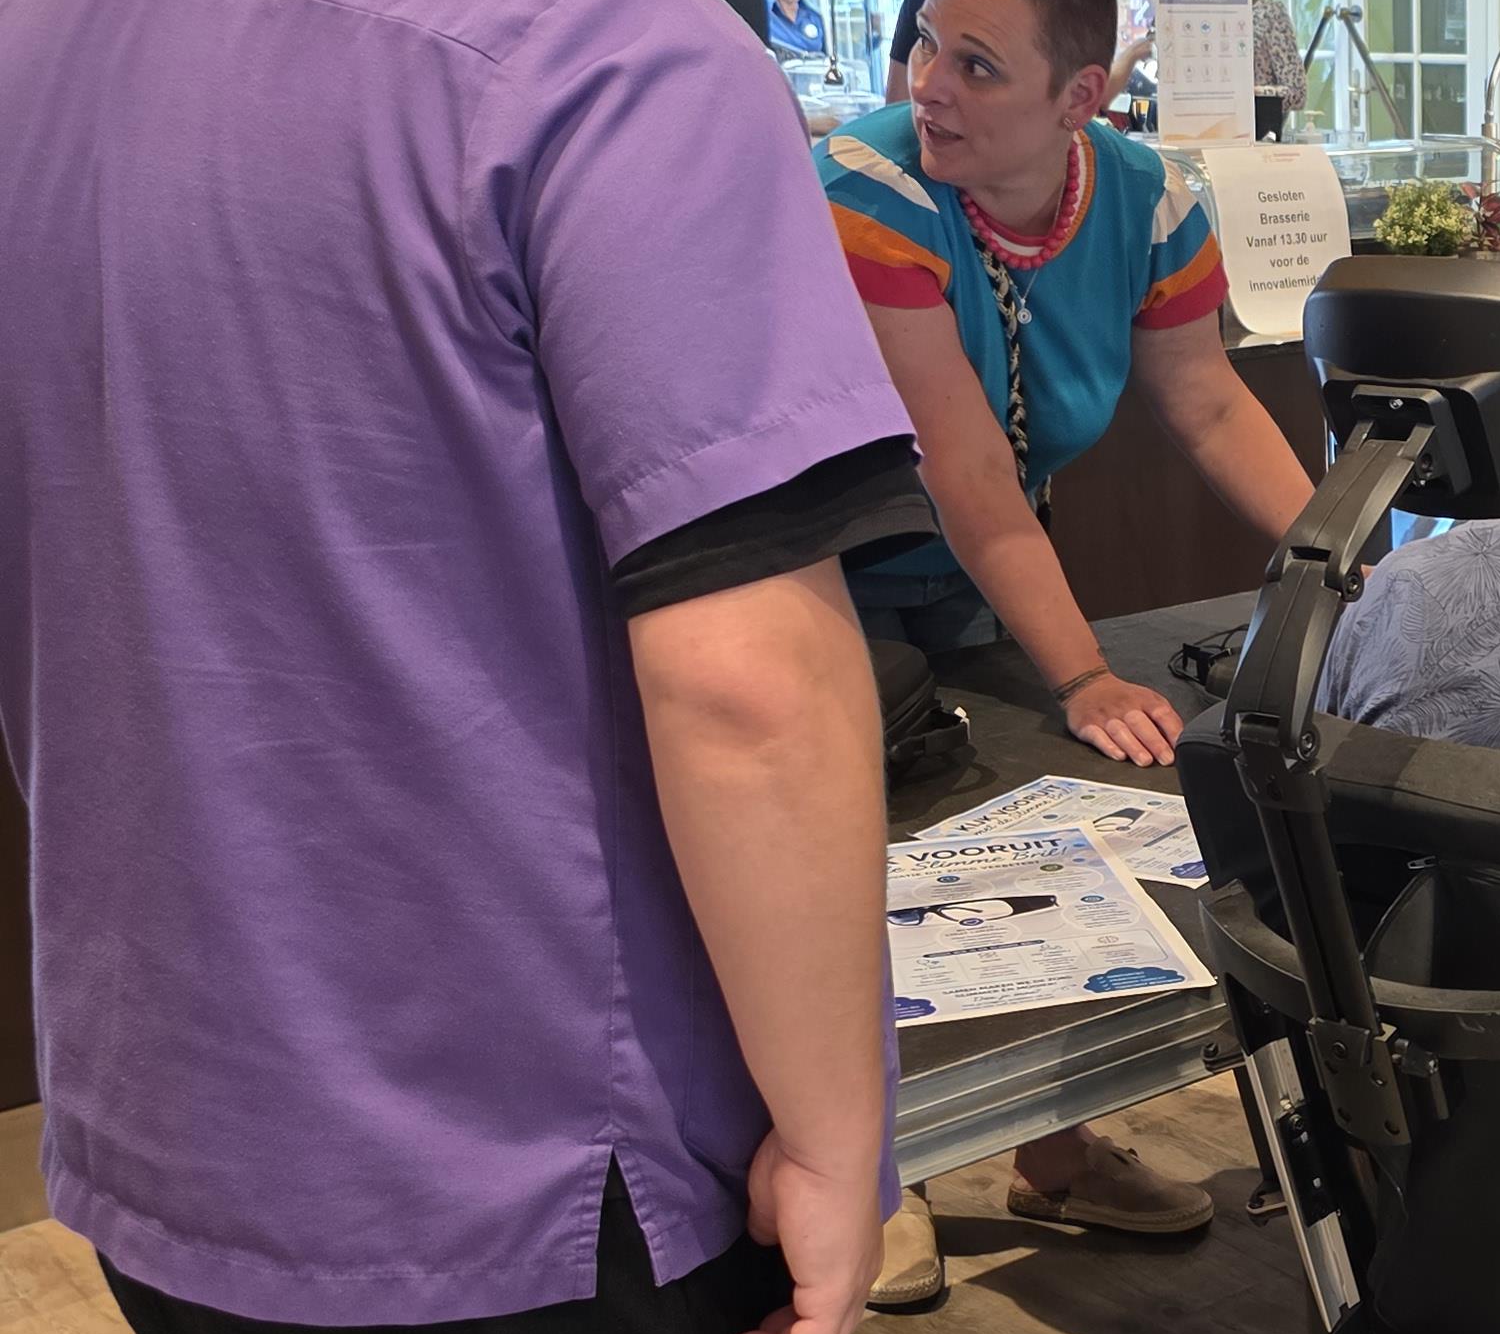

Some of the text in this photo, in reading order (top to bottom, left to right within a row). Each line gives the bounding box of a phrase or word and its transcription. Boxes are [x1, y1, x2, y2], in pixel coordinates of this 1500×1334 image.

[1257, 190, 1305, 203] Gesloten
[1260, 210, 1311, 225] Brasserie
[1246, 232, 1328, 248] Vanaf 13.30 uur
[1269, 254, 1310, 268] voor de
[1249, 275, 1320, 292] innovatiemid
[990, 783, 1062, 817] VOORUIT
[907, 838, 1063, 862] VOORUIT
[915, 855, 1009, 871] Slimme
